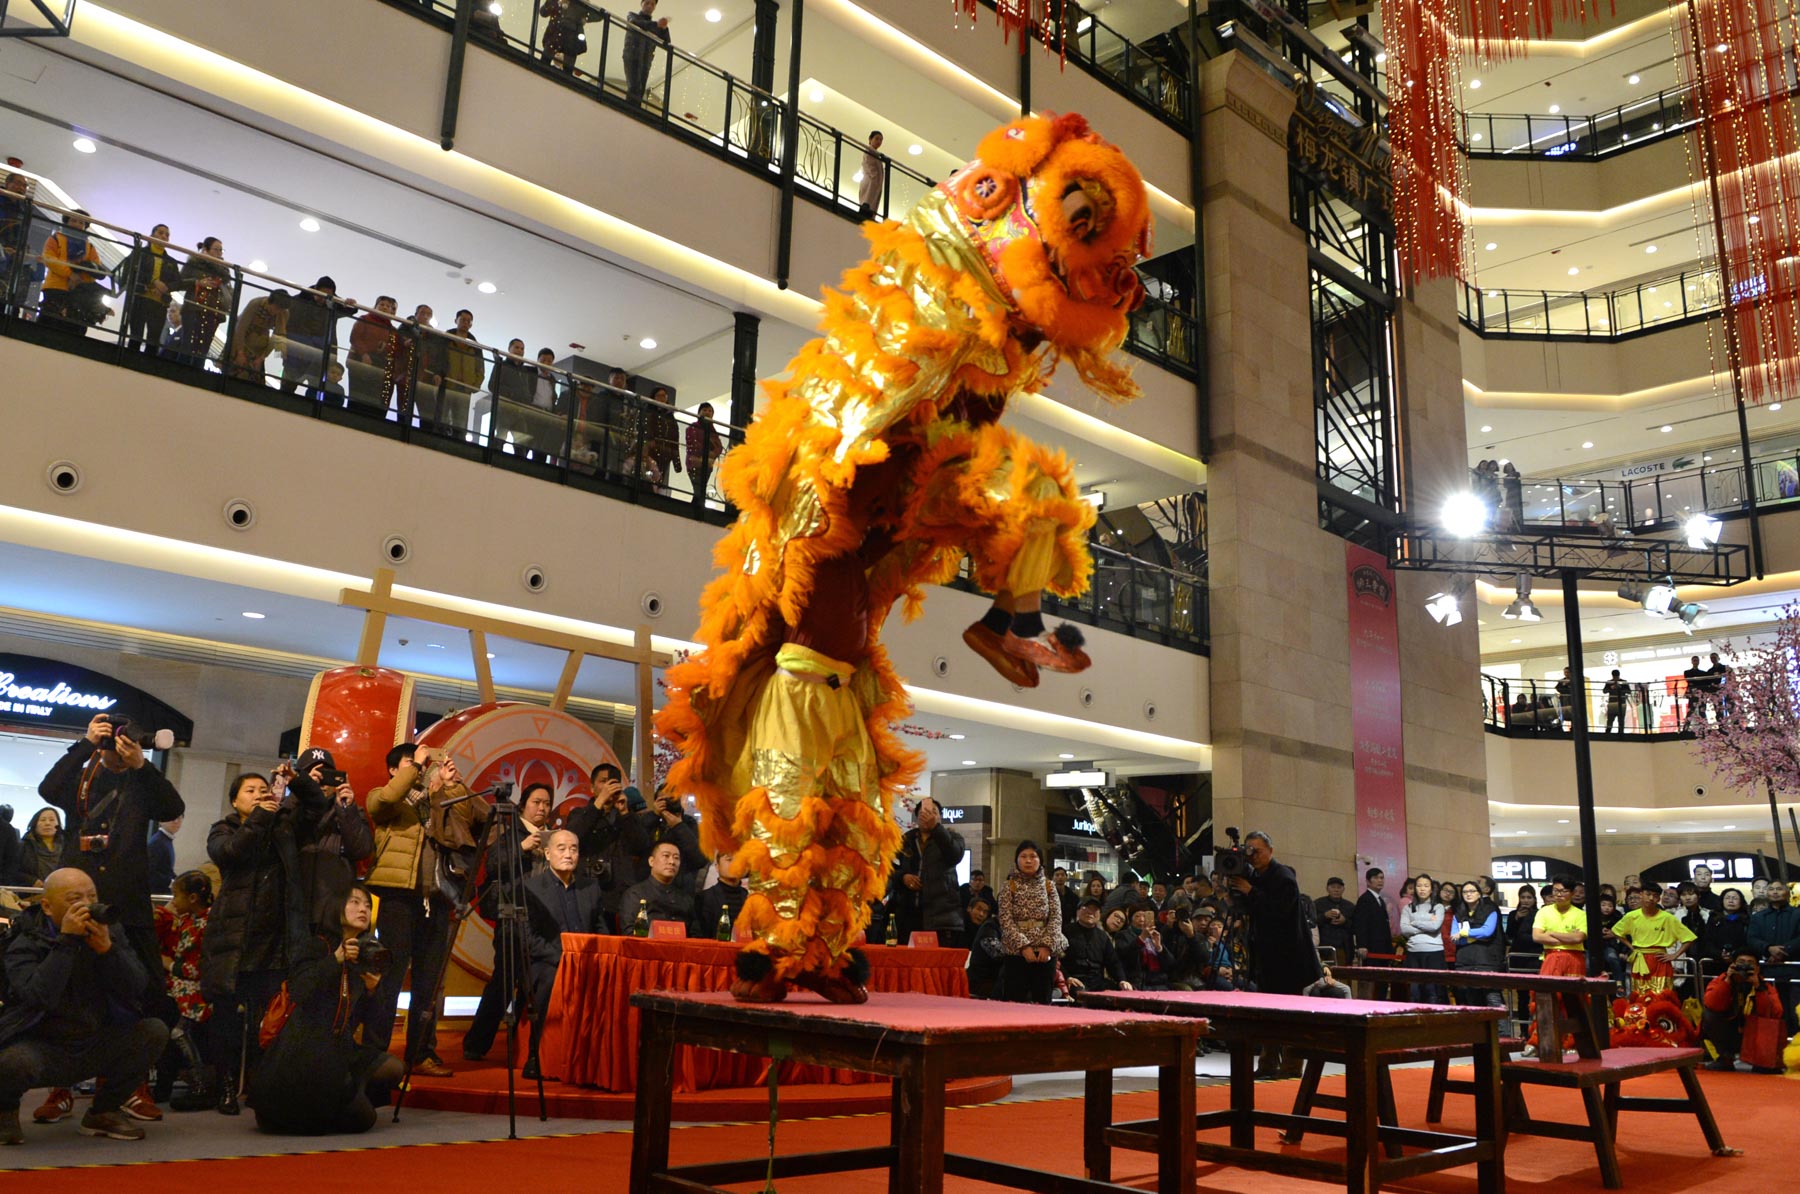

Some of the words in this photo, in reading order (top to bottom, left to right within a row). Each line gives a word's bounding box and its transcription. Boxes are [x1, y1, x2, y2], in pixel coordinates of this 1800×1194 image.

[1621, 463, 1665, 477] LACOSTE
[13, 702, 25, 713] IN
[26, 704, 53, 716] ITALY
[942, 807, 964, 823] lique
